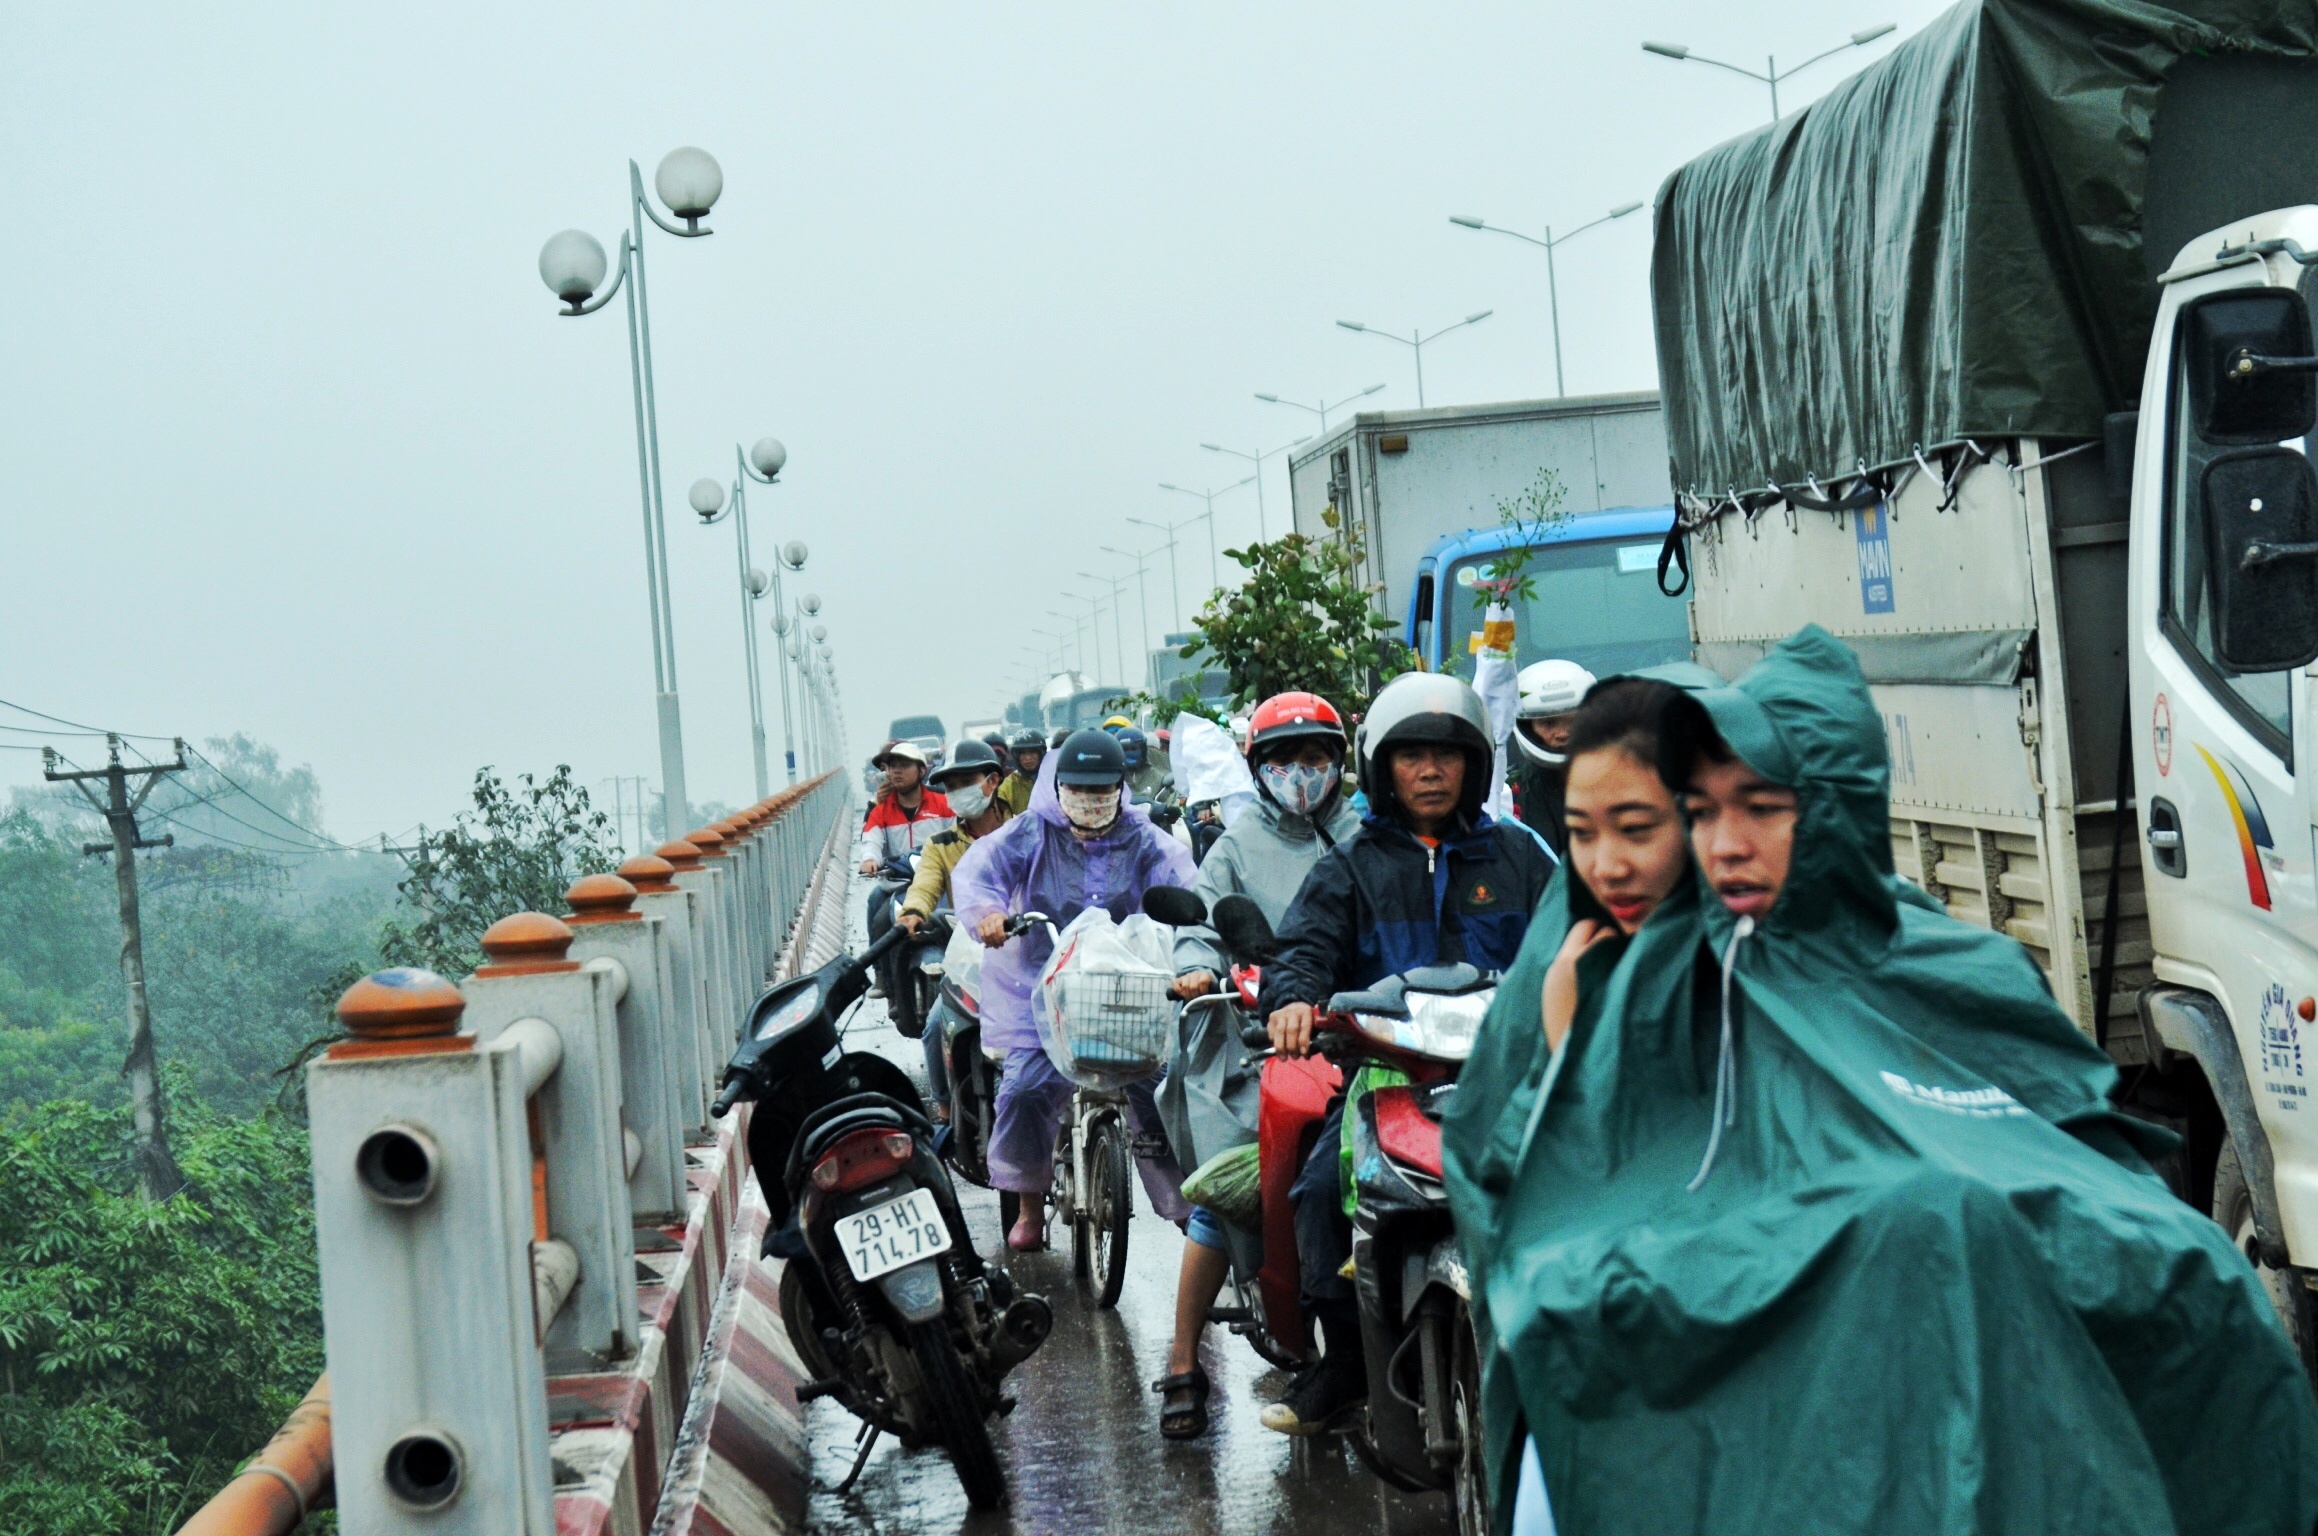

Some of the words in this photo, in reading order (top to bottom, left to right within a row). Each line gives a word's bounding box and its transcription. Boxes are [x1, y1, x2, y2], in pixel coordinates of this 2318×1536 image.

[1430, 1083, 1458, 1096] HON
[852, 1198, 922, 1244] 29-H1
[855, 1222, 942, 1274] 714.78
